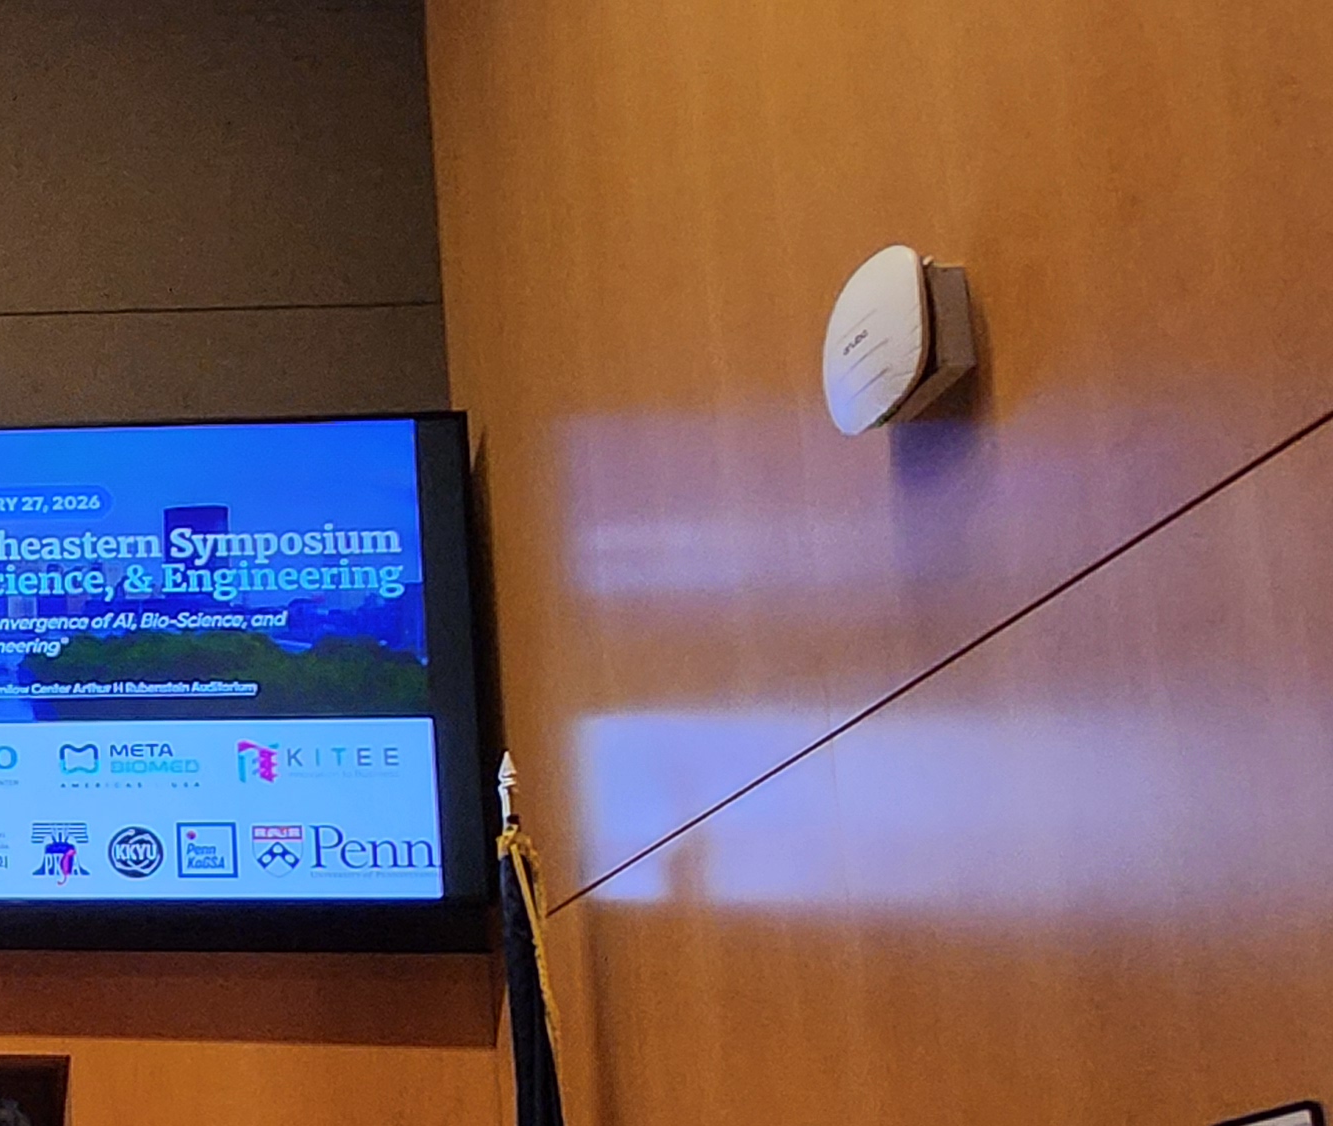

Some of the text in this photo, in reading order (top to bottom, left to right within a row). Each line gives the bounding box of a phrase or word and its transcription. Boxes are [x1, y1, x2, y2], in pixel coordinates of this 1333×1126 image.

[21, 496, 49, 513] 27,
[52, 494, 101, 512] 2026
[170, 523, 402, 566] Symposium
[123, 564, 153, 594] &
[161, 558, 406, 600] Engineering
[91, 612, 113, 629] of
[112, 612, 138, 631] AI,
[140, 611, 248, 630] Bio-Science,
[251, 610, 289, 627] and
[109, 743, 174, 758] META
[286, 747, 400, 768] KITEE
[109, 759, 201, 774] BIOMED
[115, 843, 157, 861] KKYU
[186, 843, 217, 855] Penn
[308, 824, 443, 870] Penn
